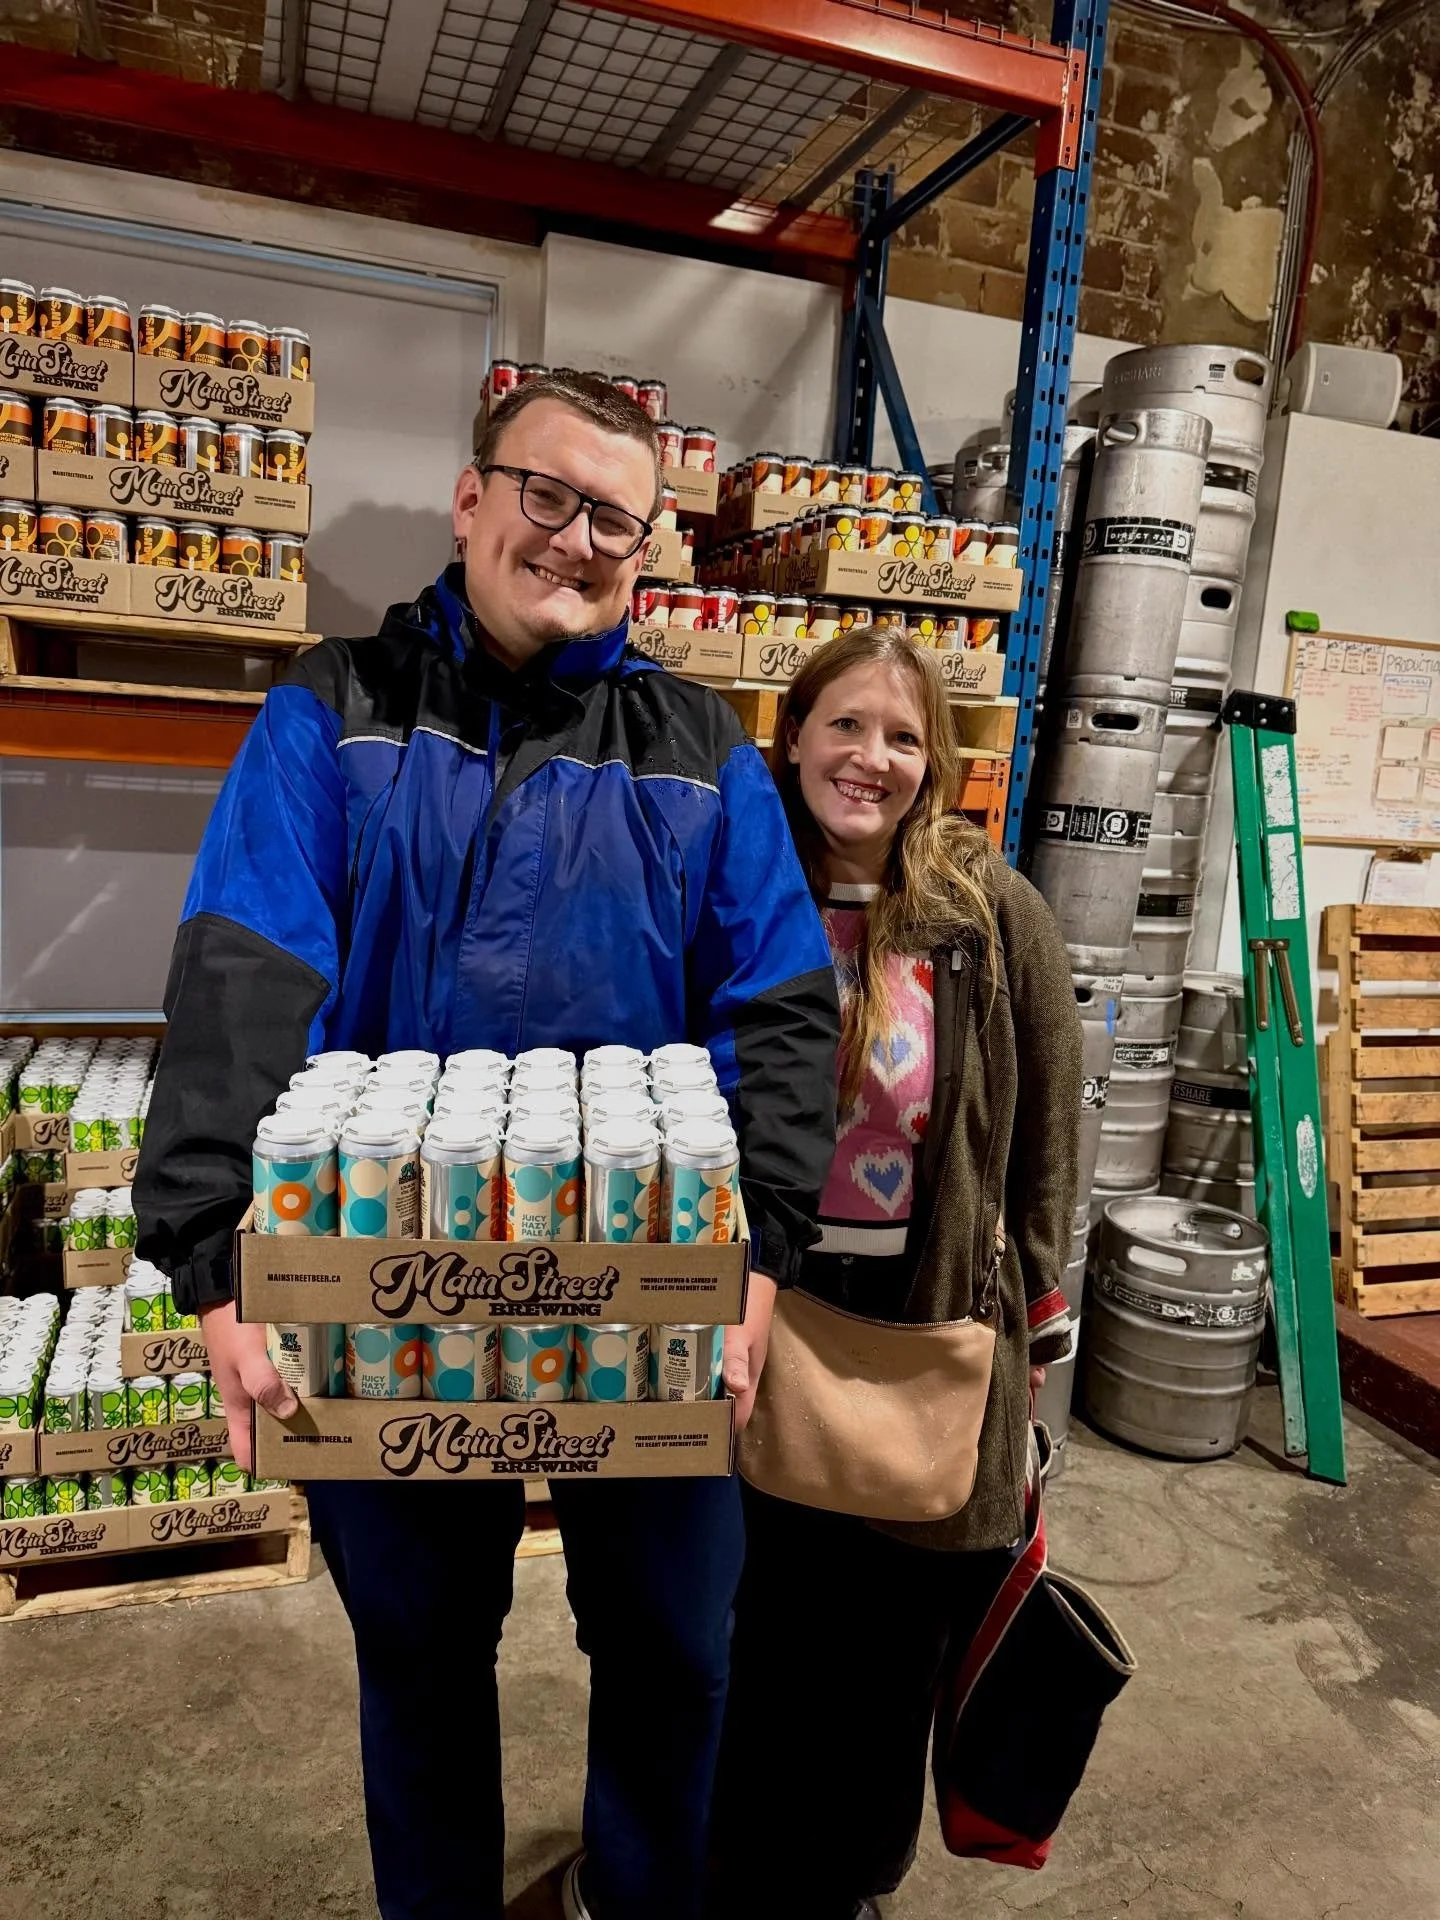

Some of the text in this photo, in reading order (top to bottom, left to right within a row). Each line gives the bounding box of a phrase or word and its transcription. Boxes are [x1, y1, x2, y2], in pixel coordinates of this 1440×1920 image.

[38, 342, 108, 383] Street
[33, 374, 99, 392] BREWING
[159, 369, 292, 414] Main Street
[223, 405, 283, 423] BREWING
[109, 466, 244, 508] Main Street
[174, 501, 235, 517] BREWING
[40, 558, 109, 595] Street
[878, 560, 976, 595] Main Street
[35, 590, 99, 604] BREWING
[155, 574, 286, 613] Main Street
[922, 589, 967, 600] BREWING
[217, 607, 276, 621] BREWING
[640, 629, 692, 660] Street
[760, 642, 808, 677] Mai
[941, 652, 987, 682] Street
[521, 1221, 547, 1230] HAZY
[522, 1214, 547, 1223] JUICY
[521, 1227, 561, 1237] PALE ALE
[267, 1273, 341, 1283] MAINSTREETBEER.CA
[370, 1246, 620, 1319] Main Street
[488, 1302, 602, 1317] BREWING
[362, 1374, 385, 1383] JUICY
[504, 1371, 523, 1383] JUICY
[361, 1381, 385, 1390] HAZY
[504, 1379, 524, 1390] HAZY
[361, 1389, 400, 1397] PALE ALE
[504, 1387, 520, 1398] PALE
[107, 1423, 230, 1466] Main Street
[282, 1435, 353, 1444] MAINSTREETBEER.CA
[379, 1408, 615, 1477] Main Street
[166, 1446, 223, 1459] BREWING
[490, 1460, 598, 1473] BREWING
[150, 1499, 270, 1542] Main Street
[45, 1518, 107, 1547] Street
[206, 1522, 263, 1535] BREWING
[40, 1542, 98, 1556] BREWING
